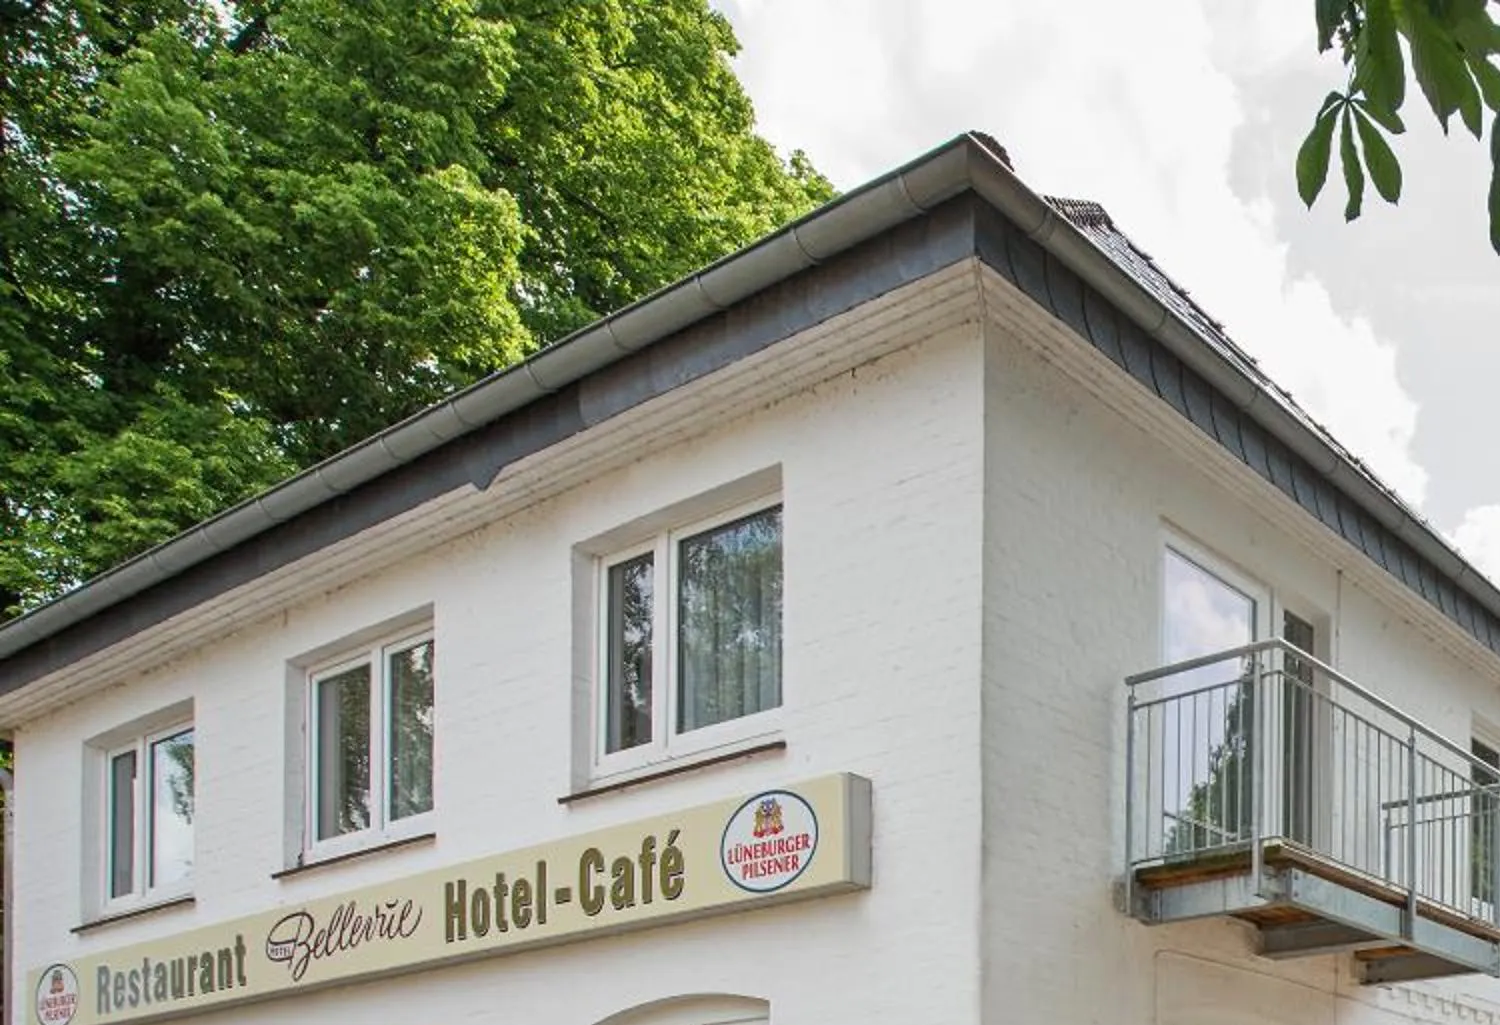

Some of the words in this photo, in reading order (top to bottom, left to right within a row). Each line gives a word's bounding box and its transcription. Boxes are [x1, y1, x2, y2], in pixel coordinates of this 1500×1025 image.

[728, 833, 811, 865] LÜNEBURGER
[742, 854, 799, 881] PILSENER
[97, 933, 247, 1015] Restaurant
